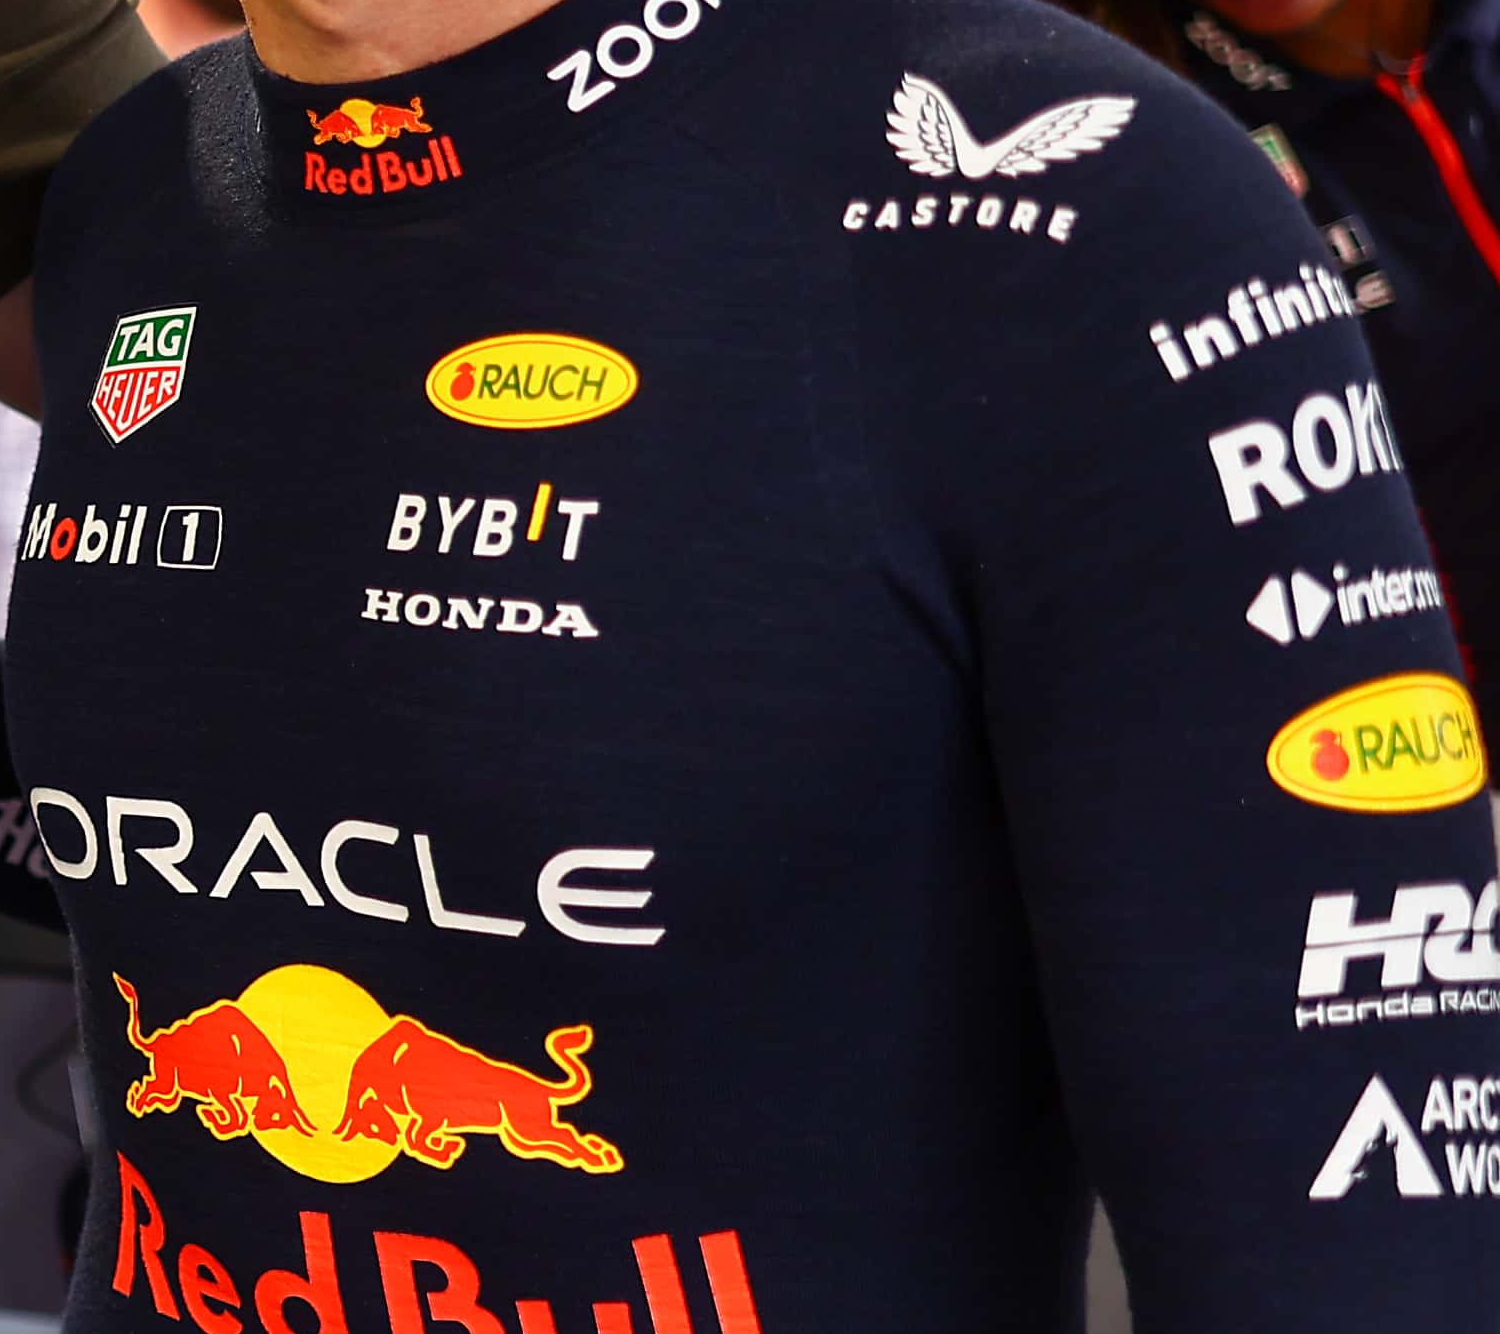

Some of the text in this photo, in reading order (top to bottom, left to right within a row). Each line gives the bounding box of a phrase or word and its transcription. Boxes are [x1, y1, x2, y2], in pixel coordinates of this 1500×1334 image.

[304, 135, 463, 197] Red Bull
[843, 195, 1076, 241] CASTORE
[117, 315, 182, 362] TAG
[99, 369, 176, 429] HEUER
[477, 363, 608, 403] RAUCH
[20, 503, 200, 568] Mobil 1
[387, 482, 599, 560] BYBIT
[361, 589, 599, 637] HONDA
[1355, 710, 1477, 774] RAUCH
[31, 788, 665, 945] ORACLE
[1295, 991, 1434, 1030] Honda
